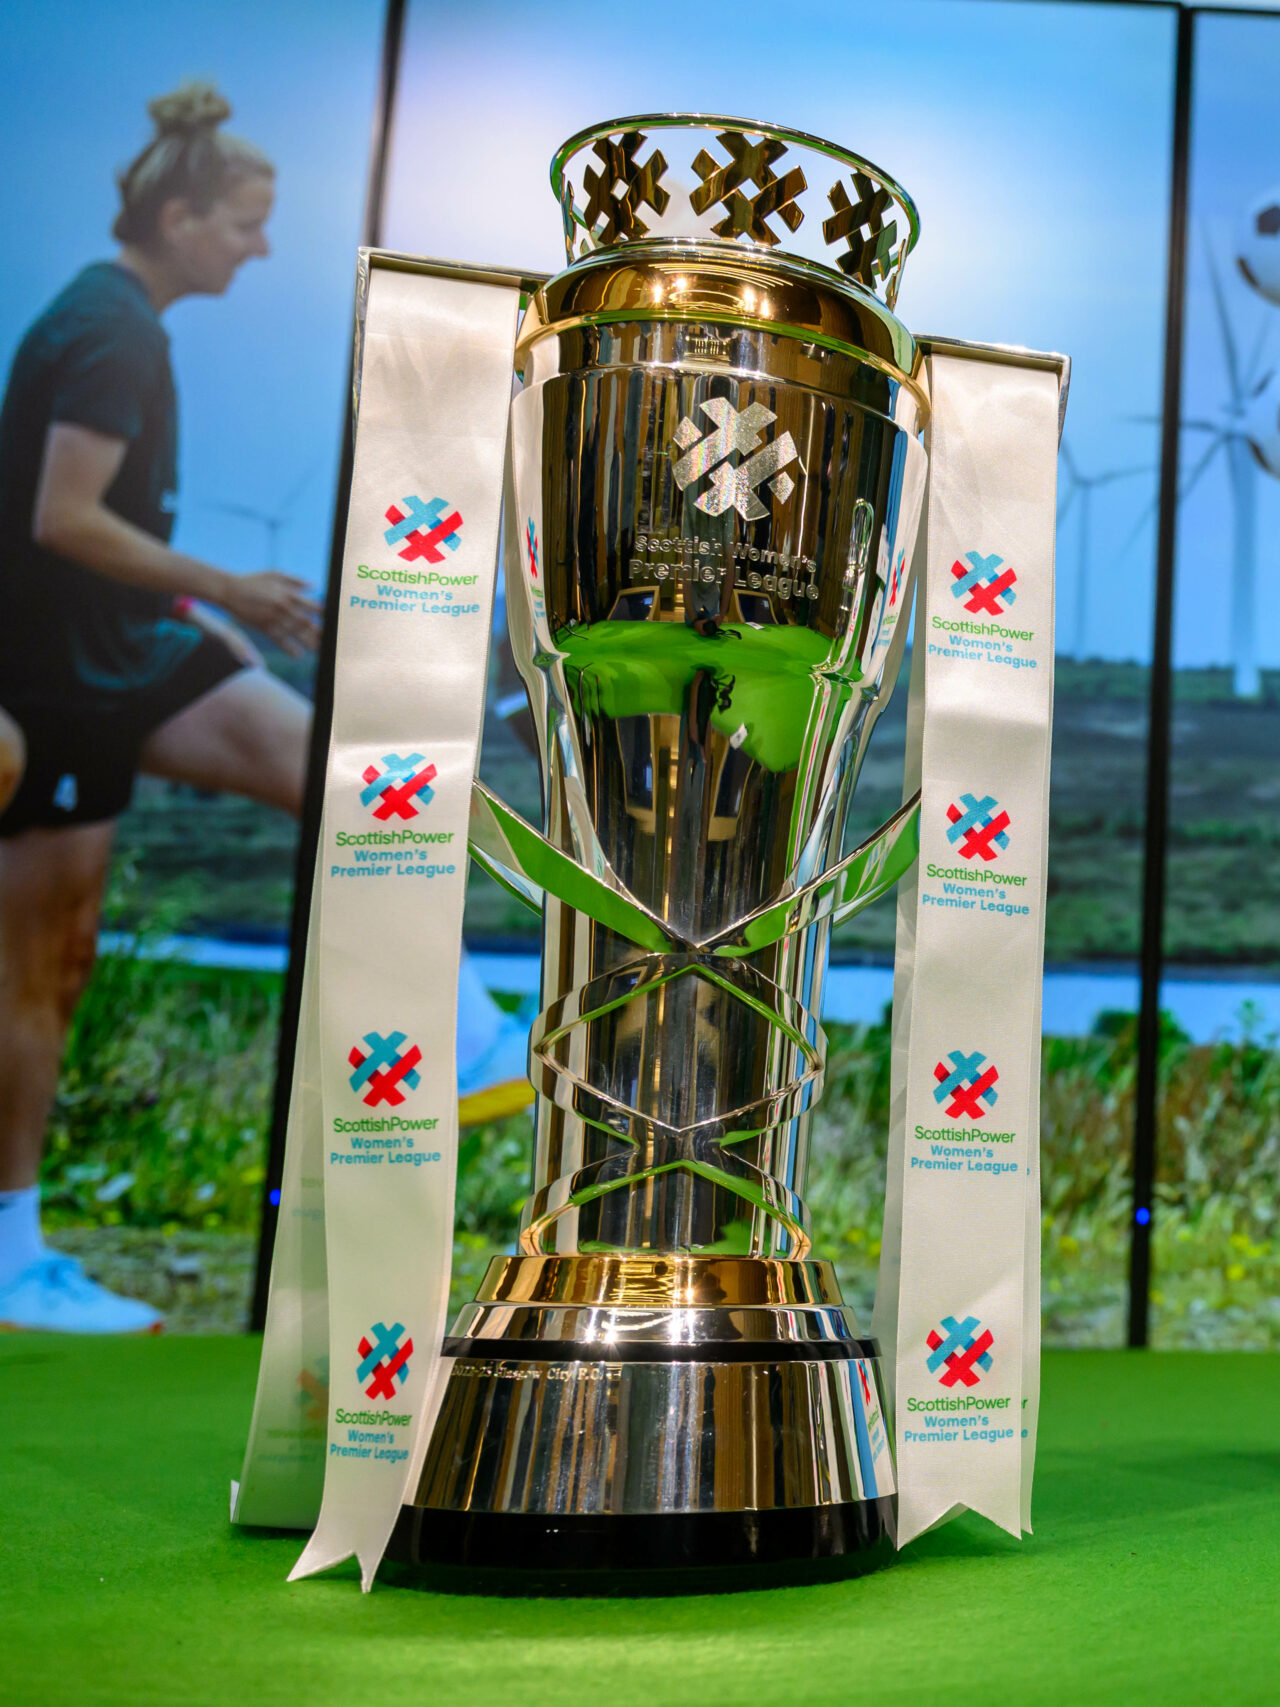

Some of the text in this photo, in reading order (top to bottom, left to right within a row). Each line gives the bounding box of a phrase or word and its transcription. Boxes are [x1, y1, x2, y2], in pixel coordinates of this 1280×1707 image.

[357, 565, 479, 586] ScottishPower
[628, 559, 819, 600] Premier League
[377, 585, 453, 600] Women's
[350, 596, 480, 617] Premier League
[932, 616, 1034, 641] ScottishPower
[949, 635, 1013, 652] Women's
[928, 644, 1037, 669] Premier League
[336, 830, 454, 846] ScottishPower
[354, 849, 427, 862] Women's
[331, 863, 456, 878] Premier League
[927, 864, 1027, 886] ScottishPower
[943, 883, 1006, 899] Women's
[922, 894, 1030, 916] Premier League
[333, 1116, 439, 1132] ScottishPower
[914, 1125, 1015, 1143] ScottishPower
[351, 1136, 414, 1149] Women's
[330, 1151, 441, 1166] Premier League
[931, 1145, 993, 1158] Women's
[911, 1157, 963, 1170] Premier
[967, 1160, 1018, 1174] League
[907, 1396, 1010, 1411] ScottishPower
[335, 1408, 412, 1426] ScottishPower
[924, 1415, 989, 1427] Women's
[348, 1430, 394, 1444] Women's
[904, 1429, 958, 1442] Premier
[963, 1429, 1014, 1443] League
[330, 1443, 372, 1457] Premier
[374, 1447, 409, 1464] League
